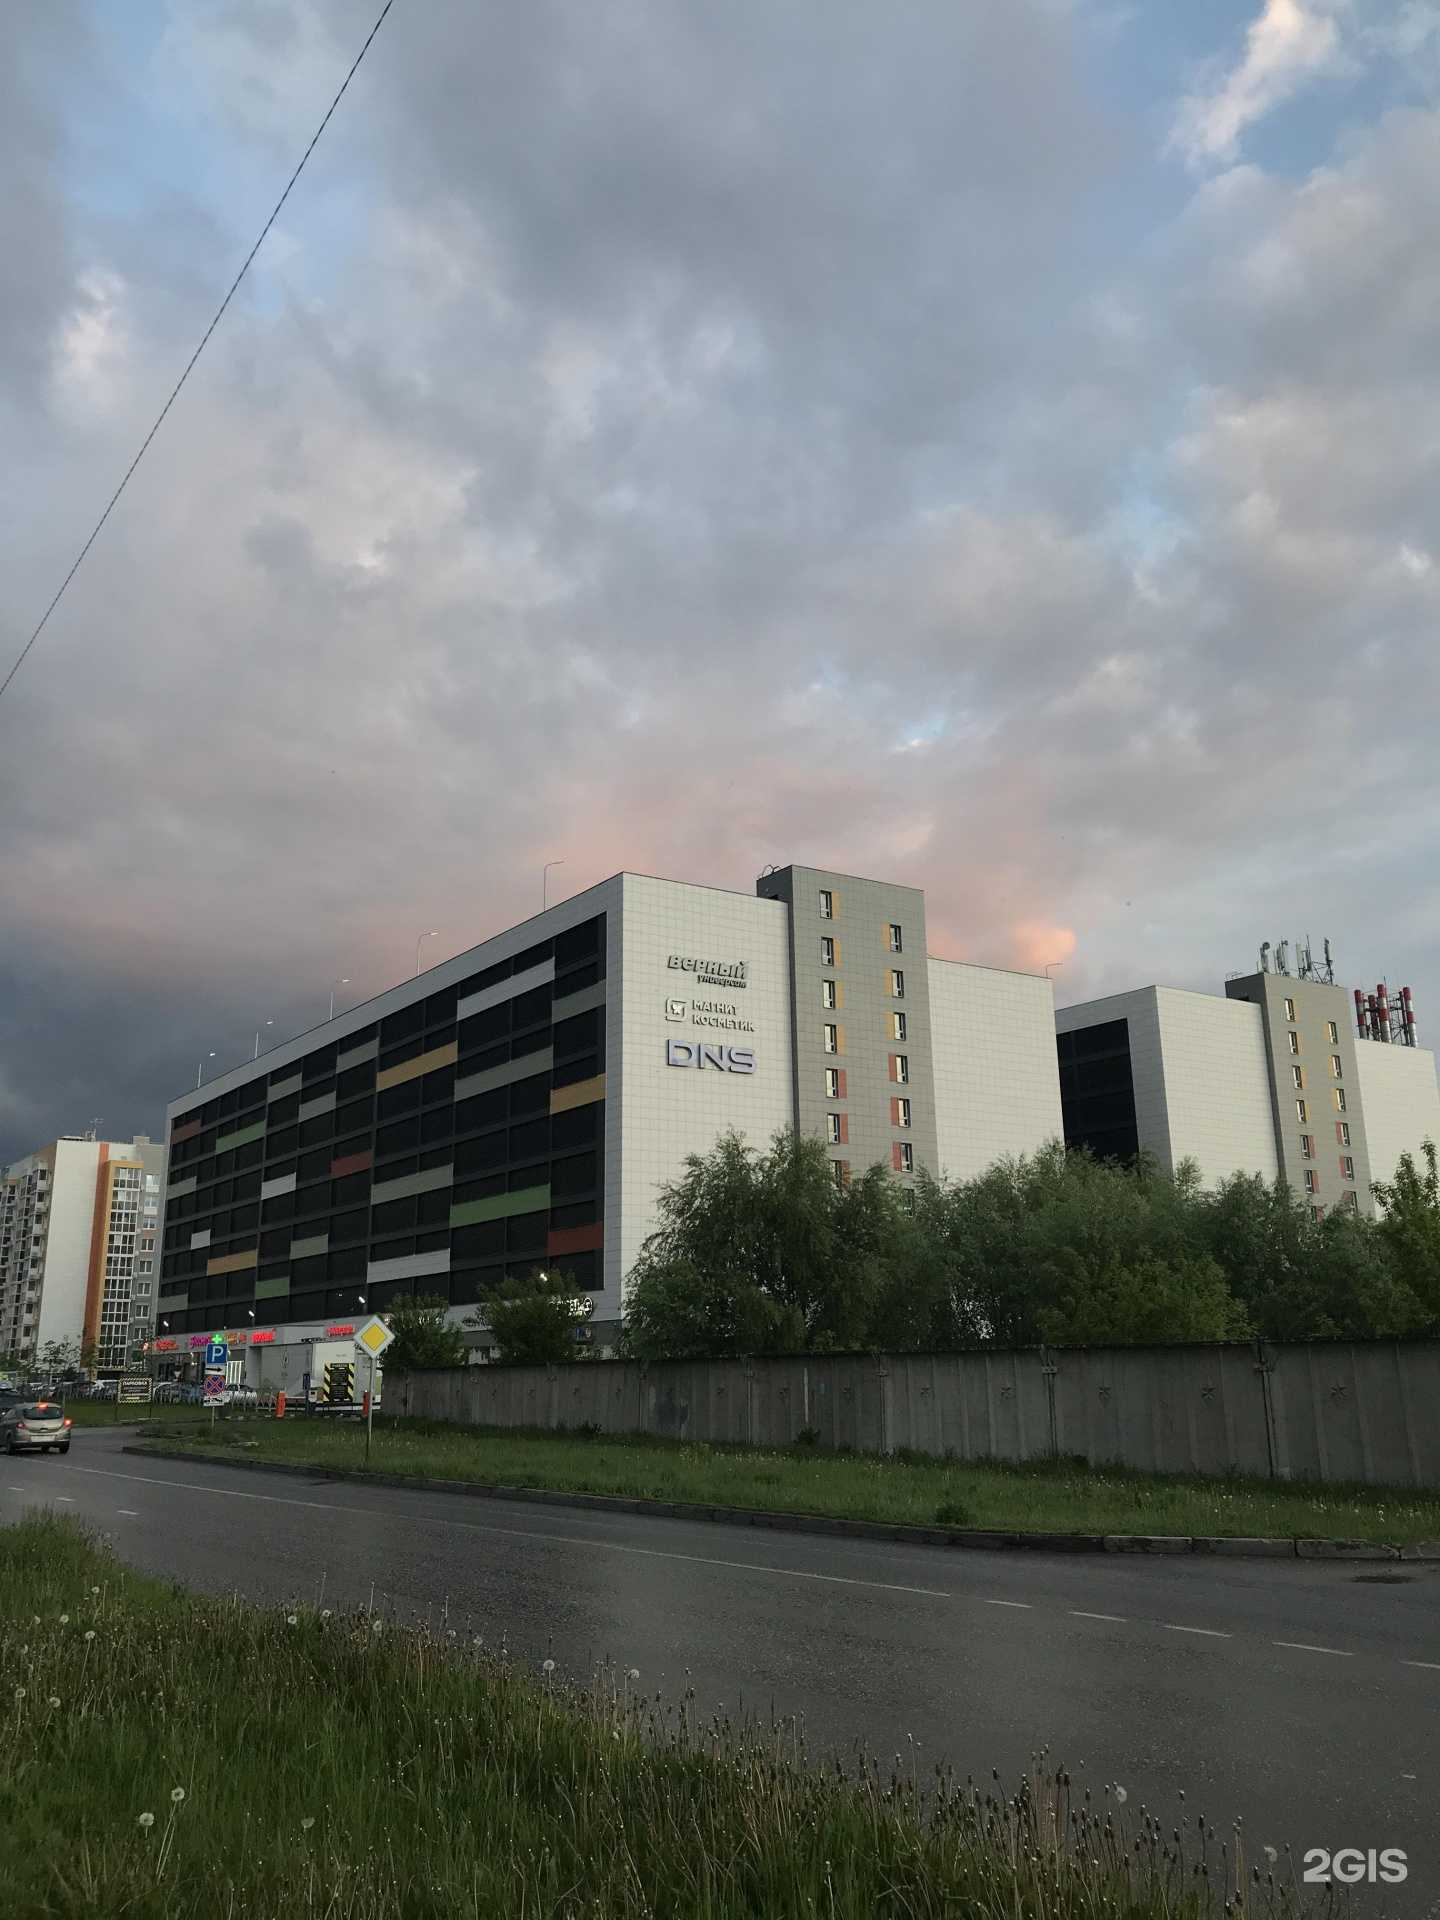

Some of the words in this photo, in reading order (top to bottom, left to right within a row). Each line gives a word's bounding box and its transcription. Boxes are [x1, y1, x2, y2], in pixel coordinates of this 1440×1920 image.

[692, 999, 737, 1016] МАГНИТ
[692, 1014, 755, 1032] КОСМЕТИК
[667, 1038, 757, 1074] DNS
